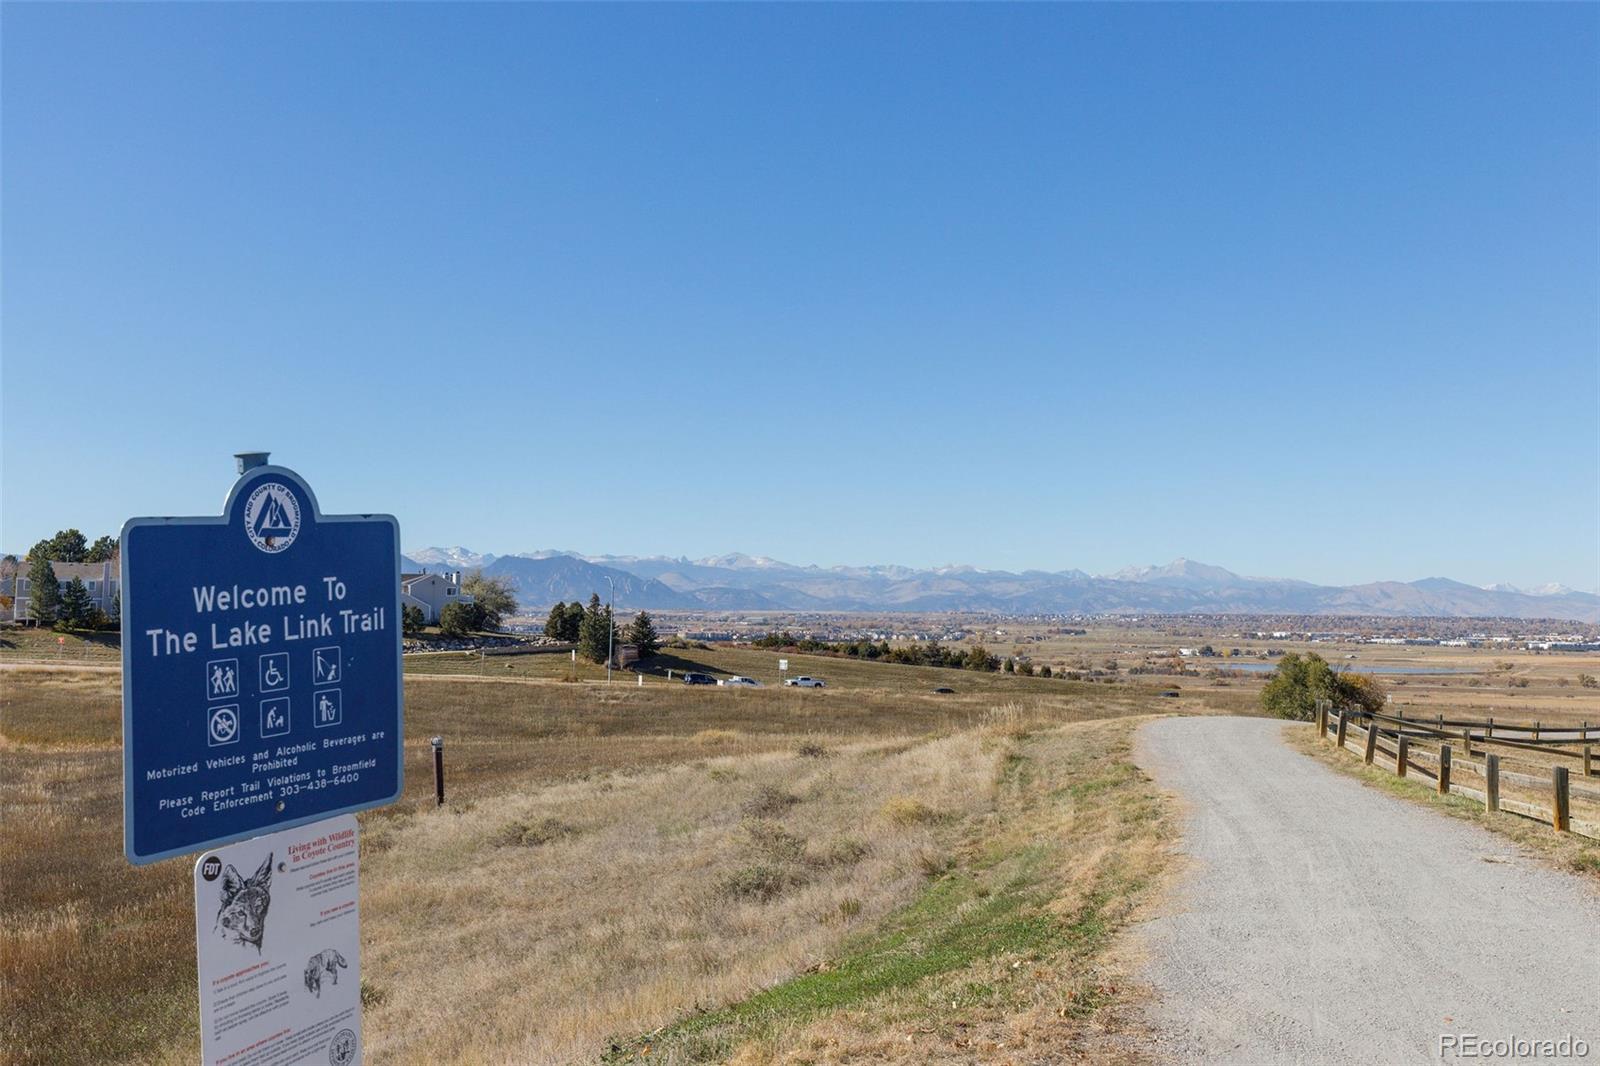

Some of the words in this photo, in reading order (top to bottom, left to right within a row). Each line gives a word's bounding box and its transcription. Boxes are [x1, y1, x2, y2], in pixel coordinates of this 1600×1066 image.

[251, 484, 276, 500] COUNTY
[277, 485, 285, 493] OF
[246, 501, 254, 518] AND
[246, 520, 255, 538] CITY
[192, 584, 307, 613] Welcome
[323, 576, 346, 601] To
[146, 629, 198, 657] The
[211, 620, 271, 650] Lake
[284, 612, 333, 641] Link
[339, 607, 385, 634] Trail
[146, 762, 198, 781] Motorized
[206, 755, 246, 770] Vehicles
[252, 750, 269, 761] and
[275, 741, 317, 757] Alcoholic
[323, 734, 366, 749] Beverages
[372, 731, 385, 740] are
[252, 756, 298, 773] Prohibited
[159, 796, 193, 810] Please
[201, 786, 235, 801] Report
[241, 780, 260, 793] Trail
[267, 772, 311, 788] Violations
[317, 768, 326, 778] to
[332, 758, 376, 775] Broomfield
[181, 806, 206, 818] Code
[213, 790, 273, 812] Enforcement
[280, 773, 359, 797] 303-438-6400
[288, 842, 311, 855] Living
[312, 837, 327, 847] with
[292, 855, 301, 863] in
[302, 847, 327, 860] Coyote
[327, 839, 354, 853] Country
